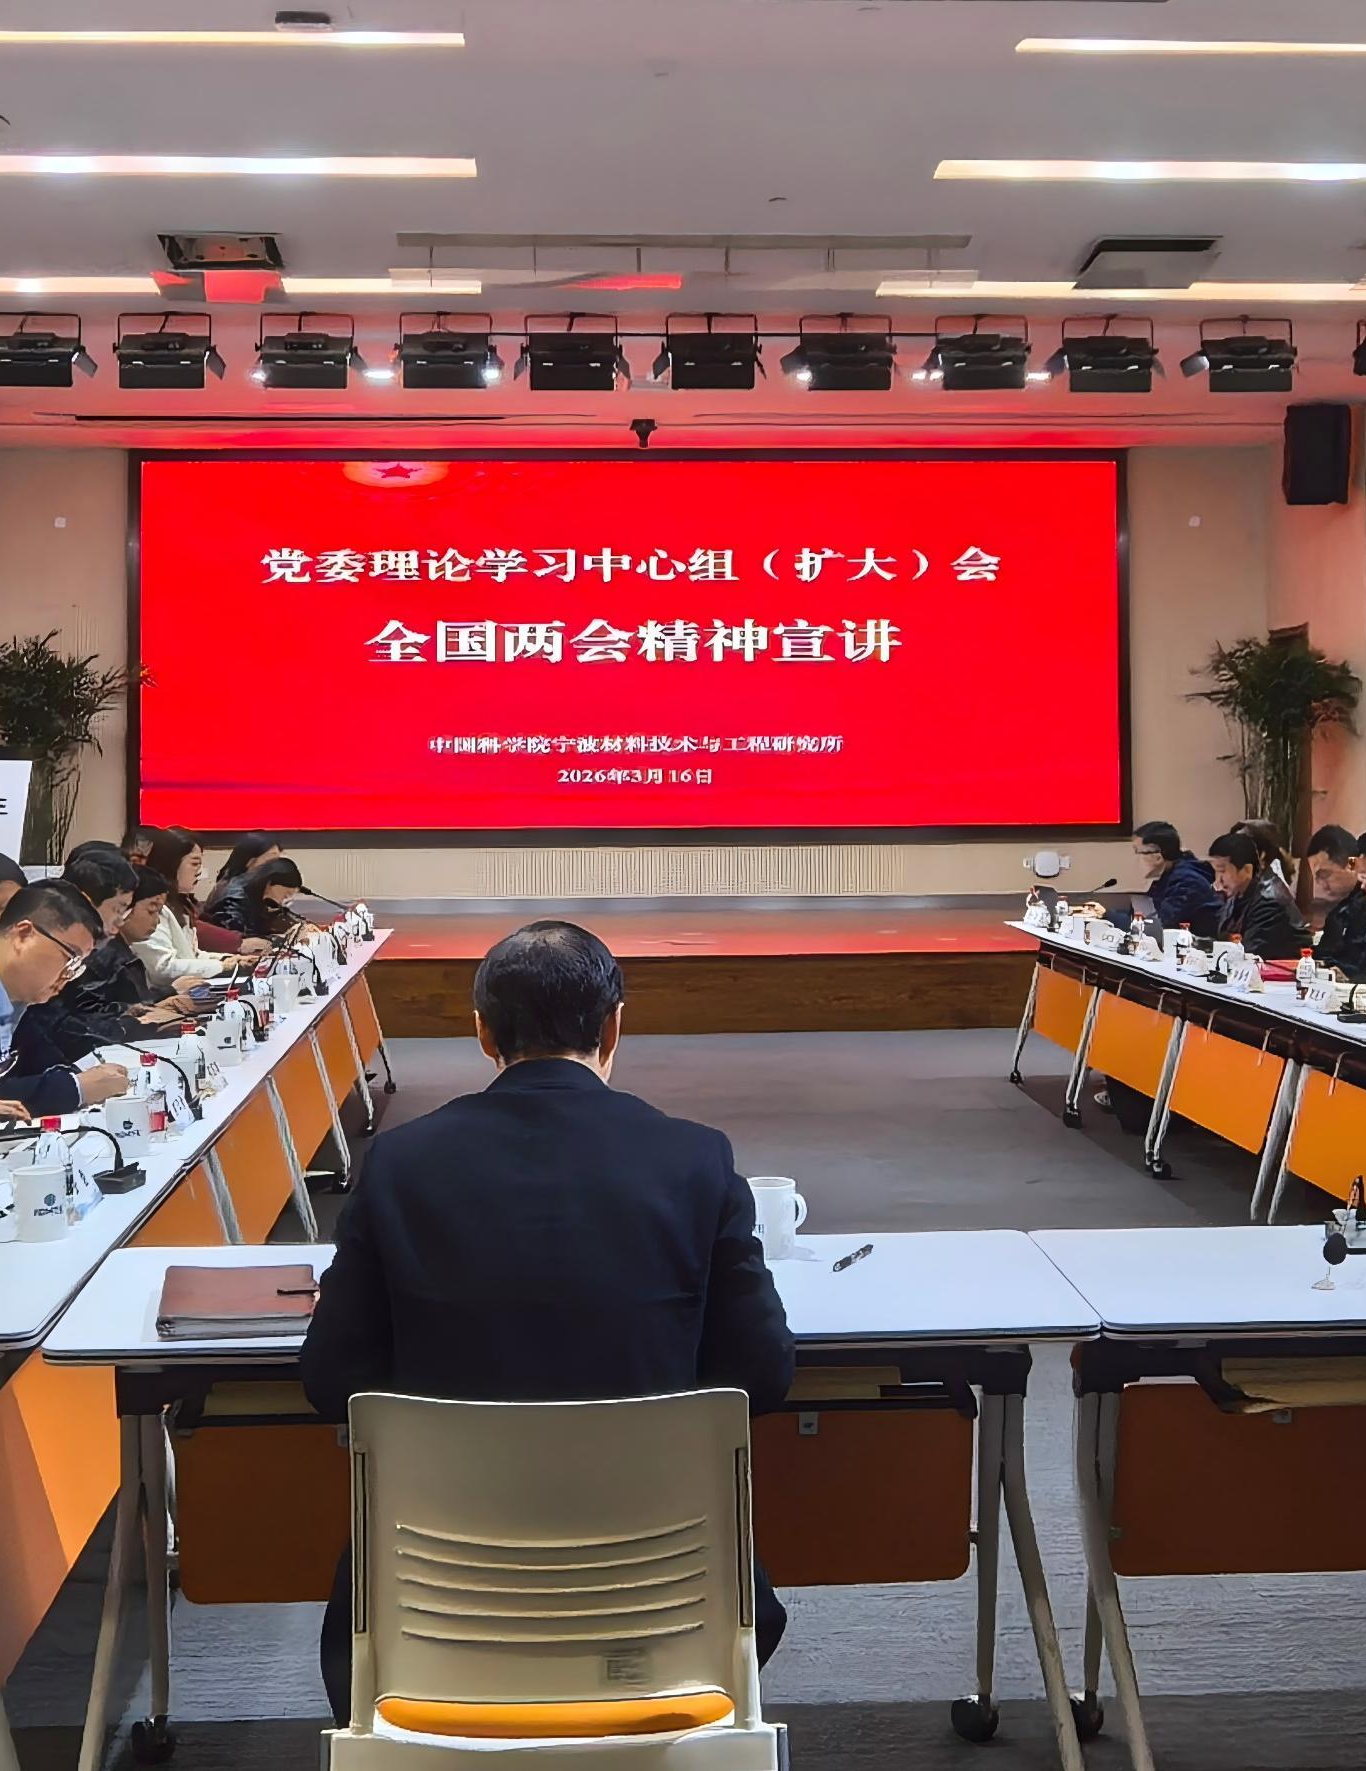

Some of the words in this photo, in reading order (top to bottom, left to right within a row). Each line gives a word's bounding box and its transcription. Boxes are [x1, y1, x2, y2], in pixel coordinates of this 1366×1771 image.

[260, 545, 1001, 584] 党委理论学习中心组（扩大）会
[364, 618, 903, 664] 全国两会精神宣讲
[428, 734, 844, 754] 中国科学院宁波材料技术与工程研究所
[557, 767, 712, 785] 2026年3月16日
